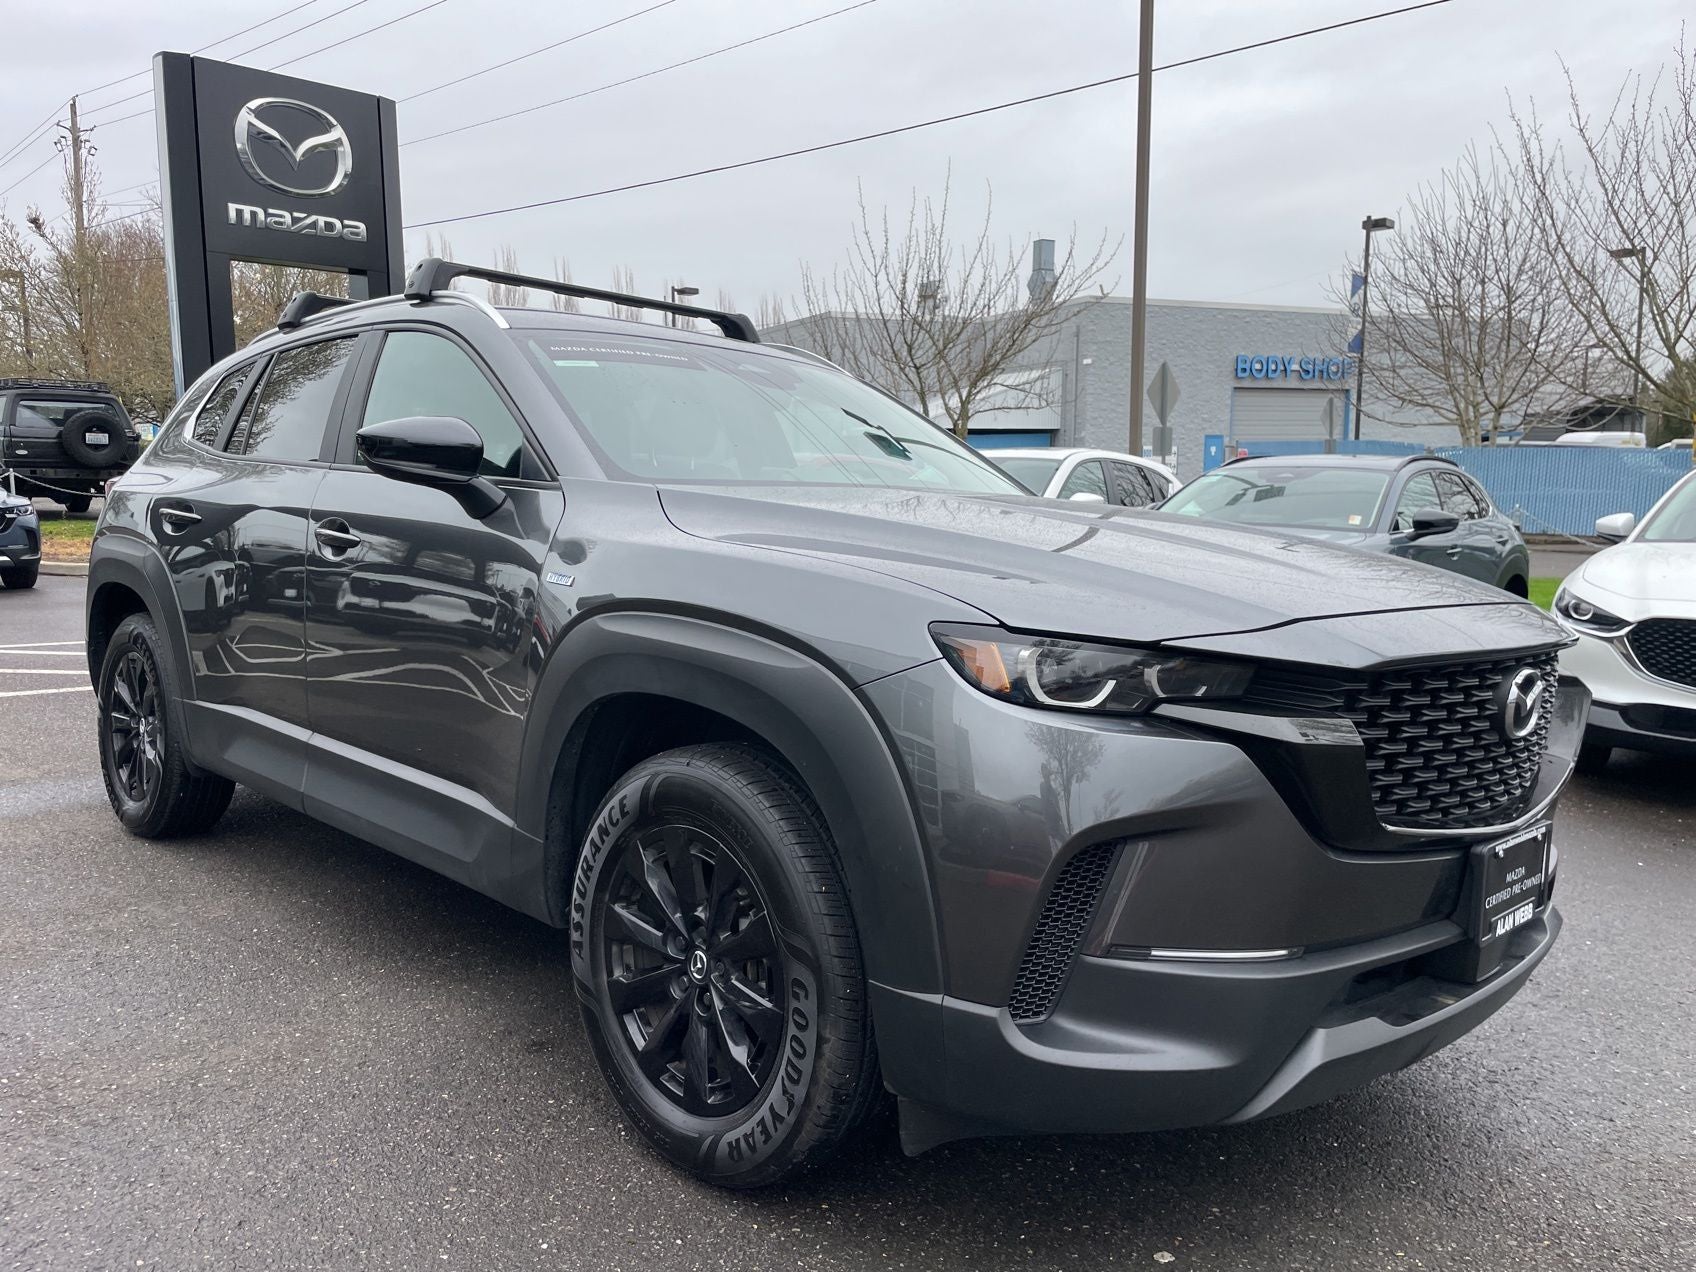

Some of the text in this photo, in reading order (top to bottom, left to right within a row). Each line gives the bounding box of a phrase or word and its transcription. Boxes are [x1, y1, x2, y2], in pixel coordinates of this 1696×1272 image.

[550, 345, 588, 353] MAZDA
[1236, 354, 1356, 380] BODY SHOP
[572, 793, 631, 961] ASSURANCE
[1485, 872, 1542, 909] CERTIFIED PRE-OWNED
[1505, 866, 1526, 884] MAZDA
[1495, 902, 1534, 938] ALAN WEBB
